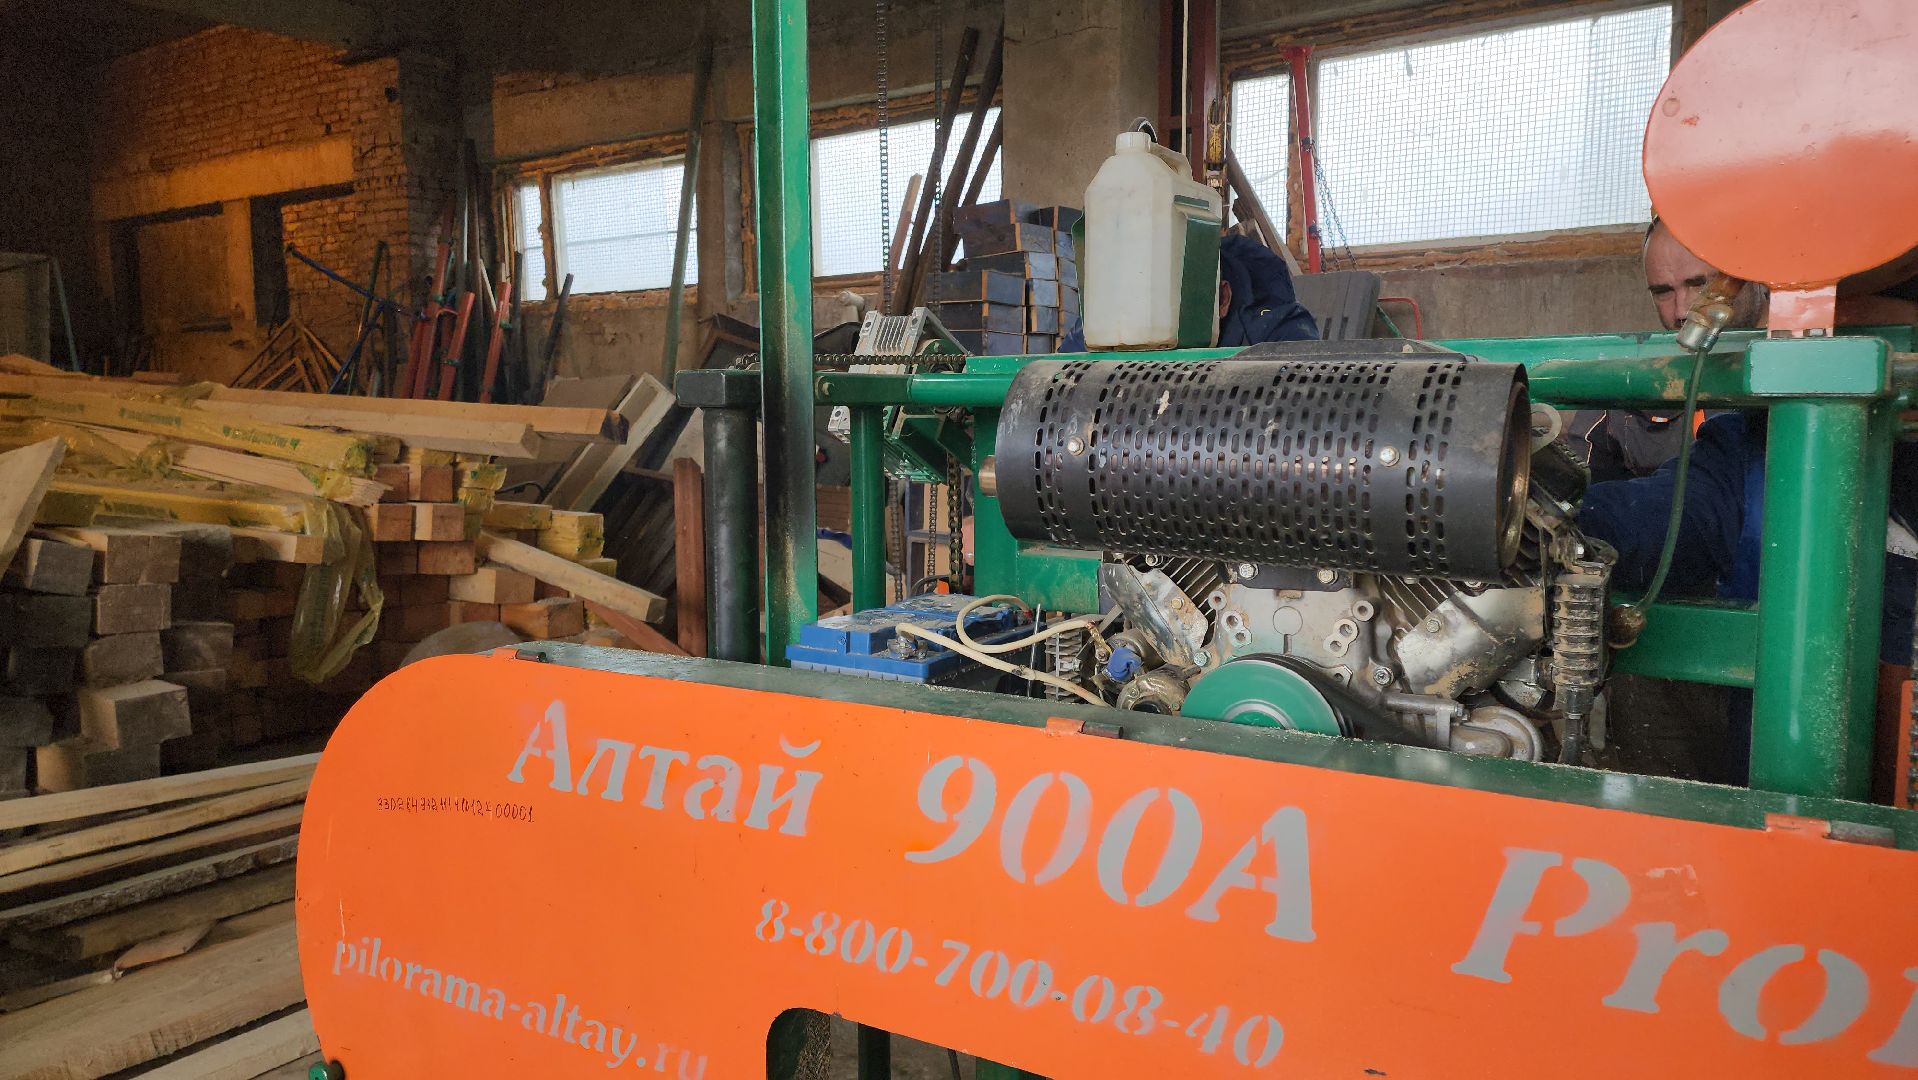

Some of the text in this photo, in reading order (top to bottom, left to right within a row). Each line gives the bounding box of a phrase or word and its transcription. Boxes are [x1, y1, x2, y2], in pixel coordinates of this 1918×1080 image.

[506, 699, 825, 837] Алтай
[332, 936, 709, 1080] pilorama-altay.ru
[755, 899, 1284, 1068] 8-800-700-08-40
